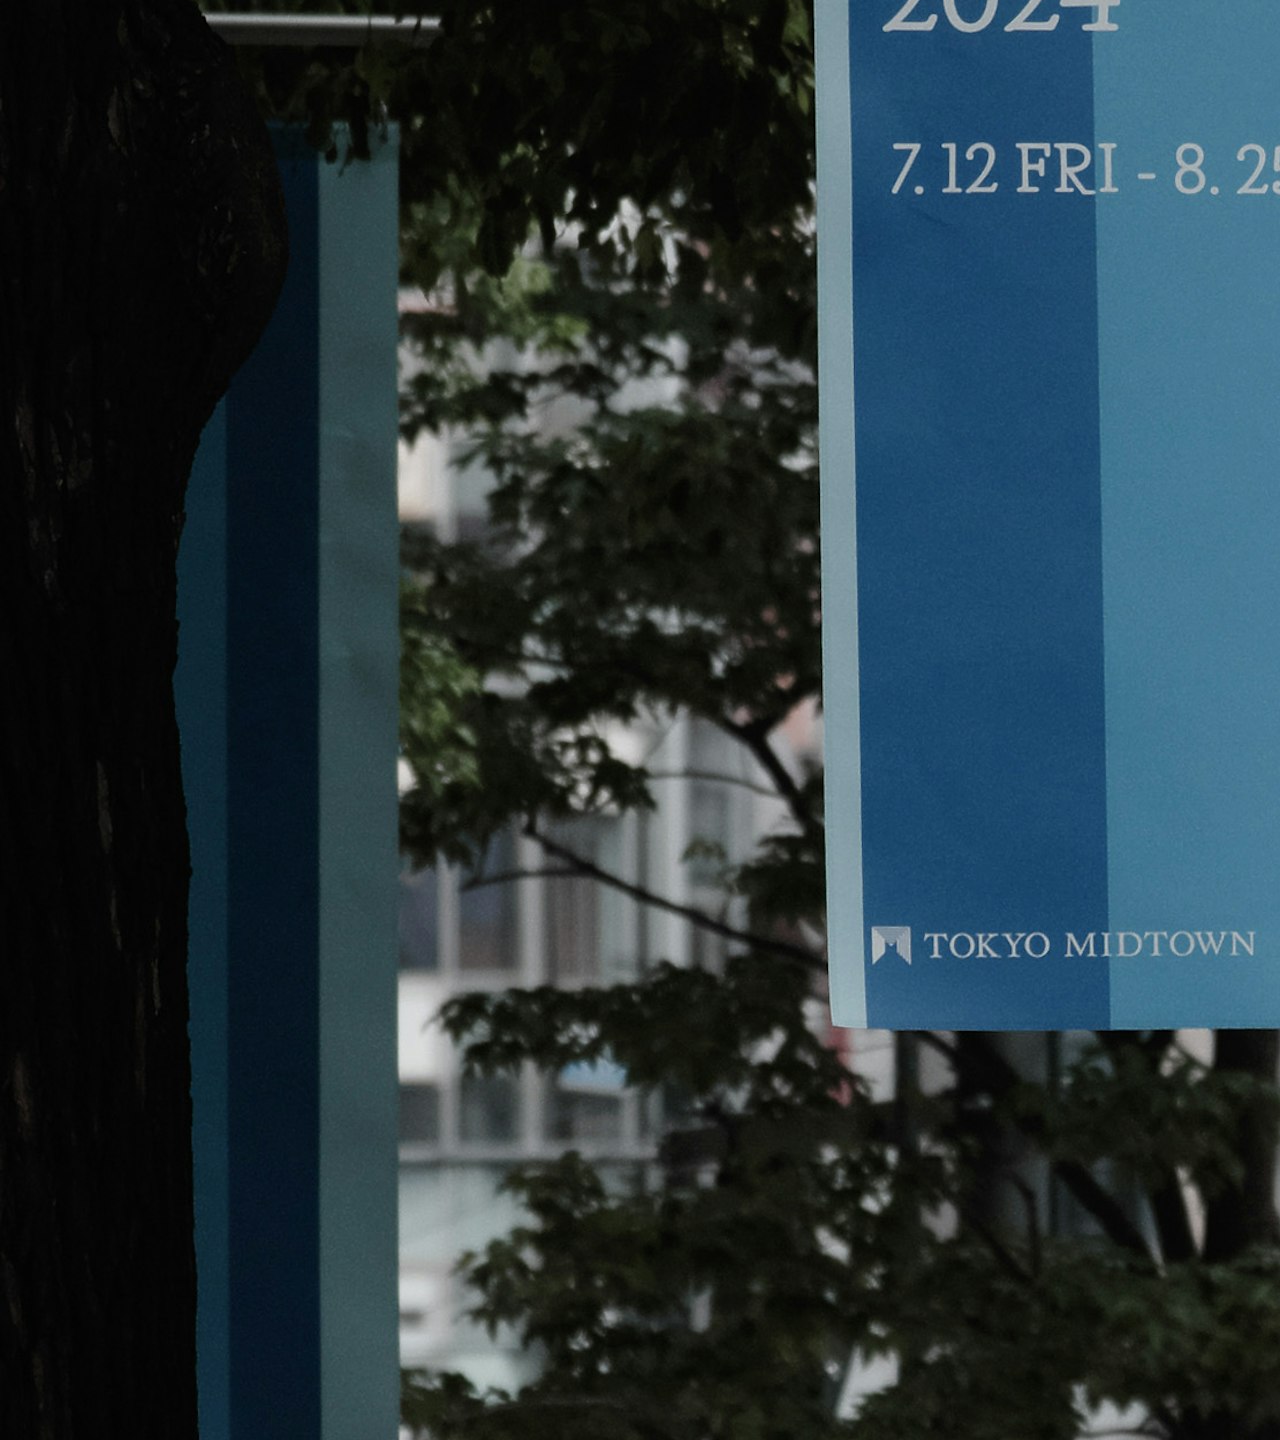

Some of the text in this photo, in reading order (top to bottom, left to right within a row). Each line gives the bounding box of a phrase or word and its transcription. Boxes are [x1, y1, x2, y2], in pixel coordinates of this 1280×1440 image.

[1015, 142, 1119, 195] FRI
[922, 930, 1256, 959] TOKYO MIDTOWN
